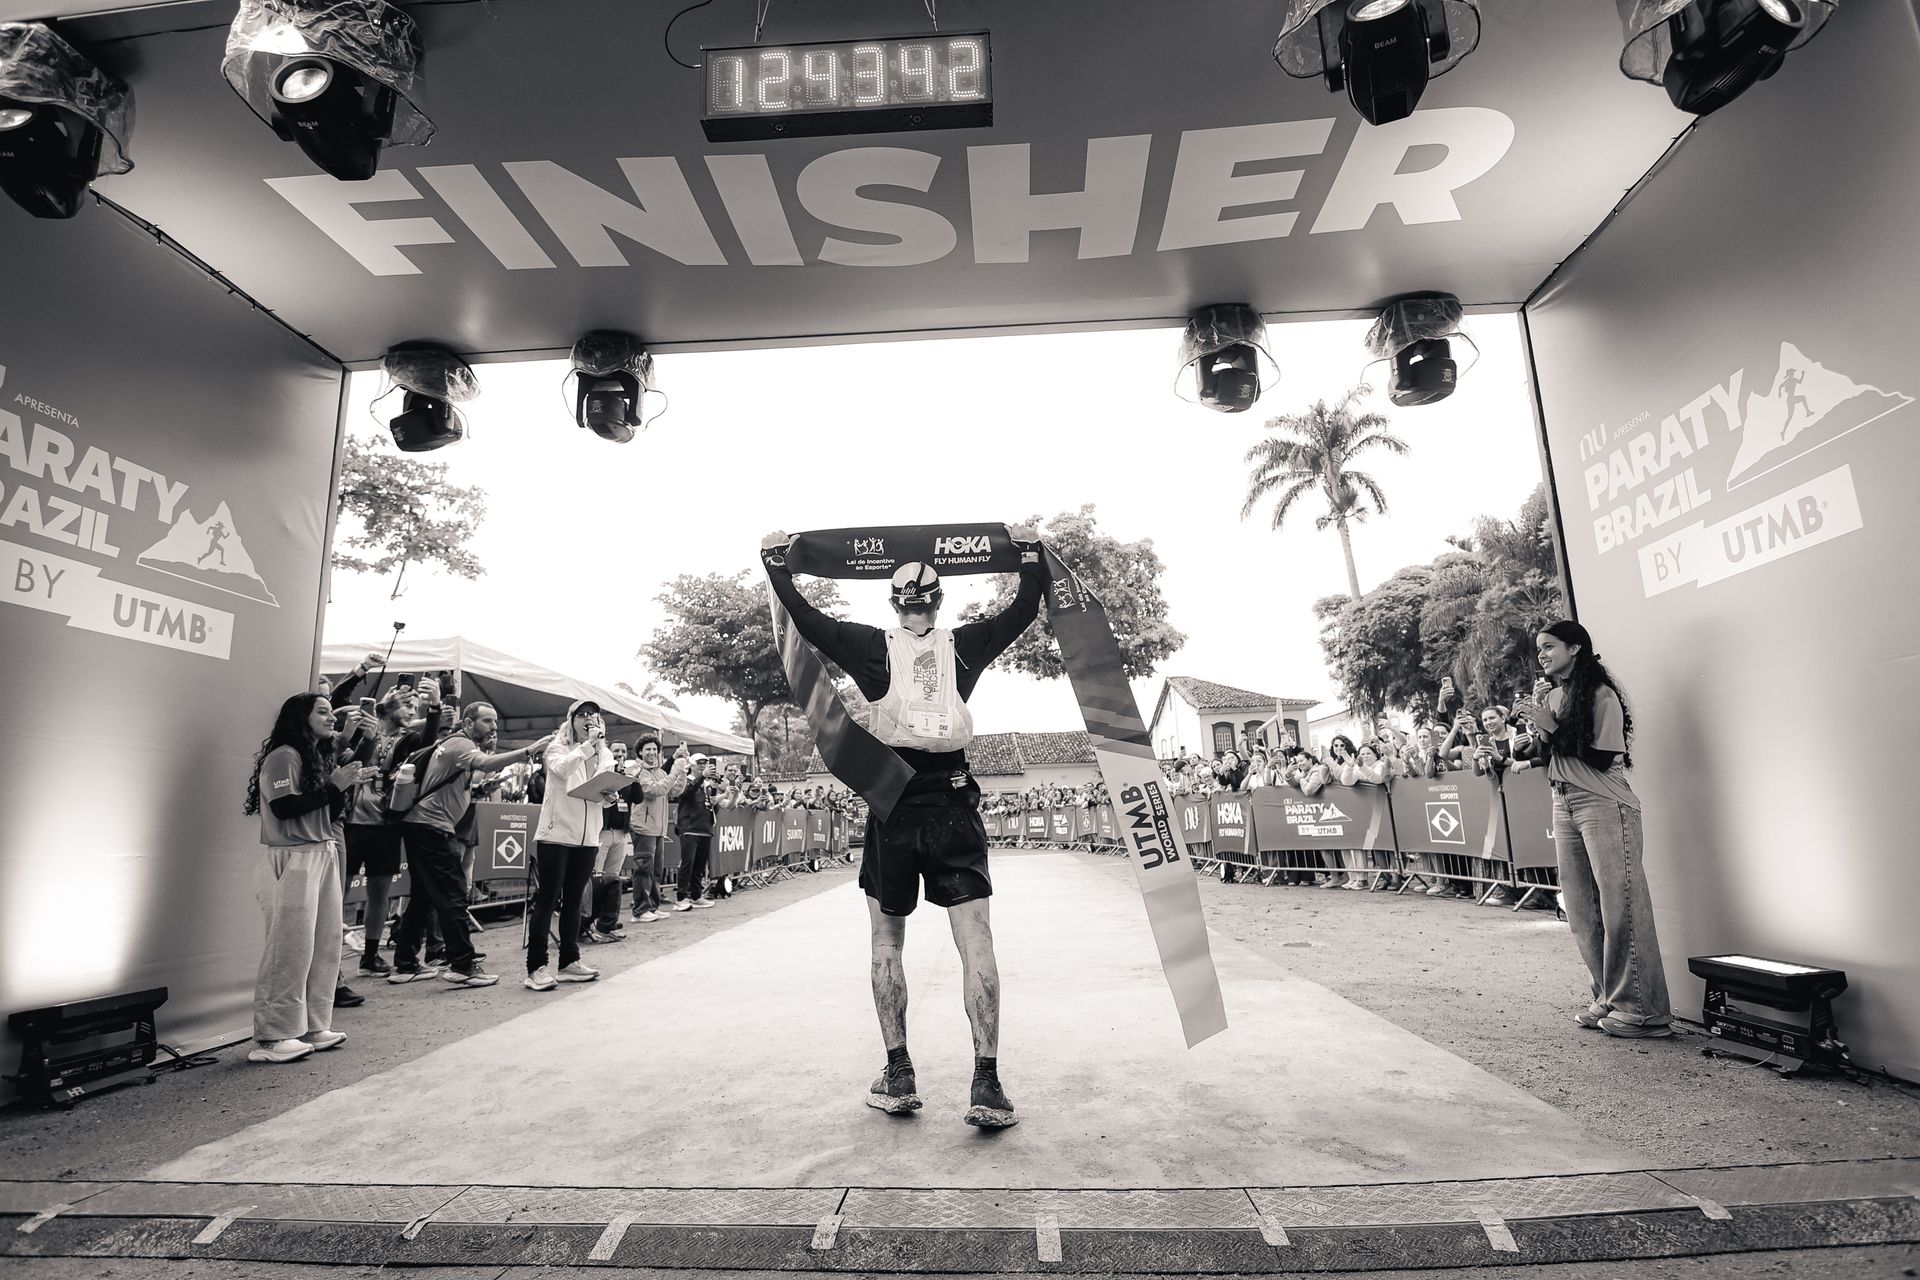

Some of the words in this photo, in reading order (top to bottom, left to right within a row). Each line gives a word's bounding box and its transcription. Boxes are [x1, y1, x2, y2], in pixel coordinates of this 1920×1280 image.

[262, 106, 1516, 276] FINISHER
[14, 393, 79, 428] APRESENTA
[1613, 410, 1650, 440] APRESENTA
[1584, 368, 1744, 511] PARATY
[0, 408, 189, 525] ARATY
[0, 480, 120, 558] AZIL
[1593, 467, 1711, 555] BRAZIL
[934, 536, 992, 554] HOKA
[934, 557, 947, 565] FLY
[948, 556, 977, 564] HUMAN
[1654, 542, 1682, 582] BY
[14, 558, 65, 599] BY
[913, 666, 922, 683] THE
[923, 669, 932, 701] NORTH
[930, 668, 939, 692] FACE
[1147, 784, 1165, 815] SERIES
[1217, 802, 1243, 824] HOKA
[1284, 803, 1324, 815] PARATY
[1286, 815, 1316, 824] BRAZIL
[719, 826, 744, 852] HOKA
[1158, 820, 1176, 859] WORLD
